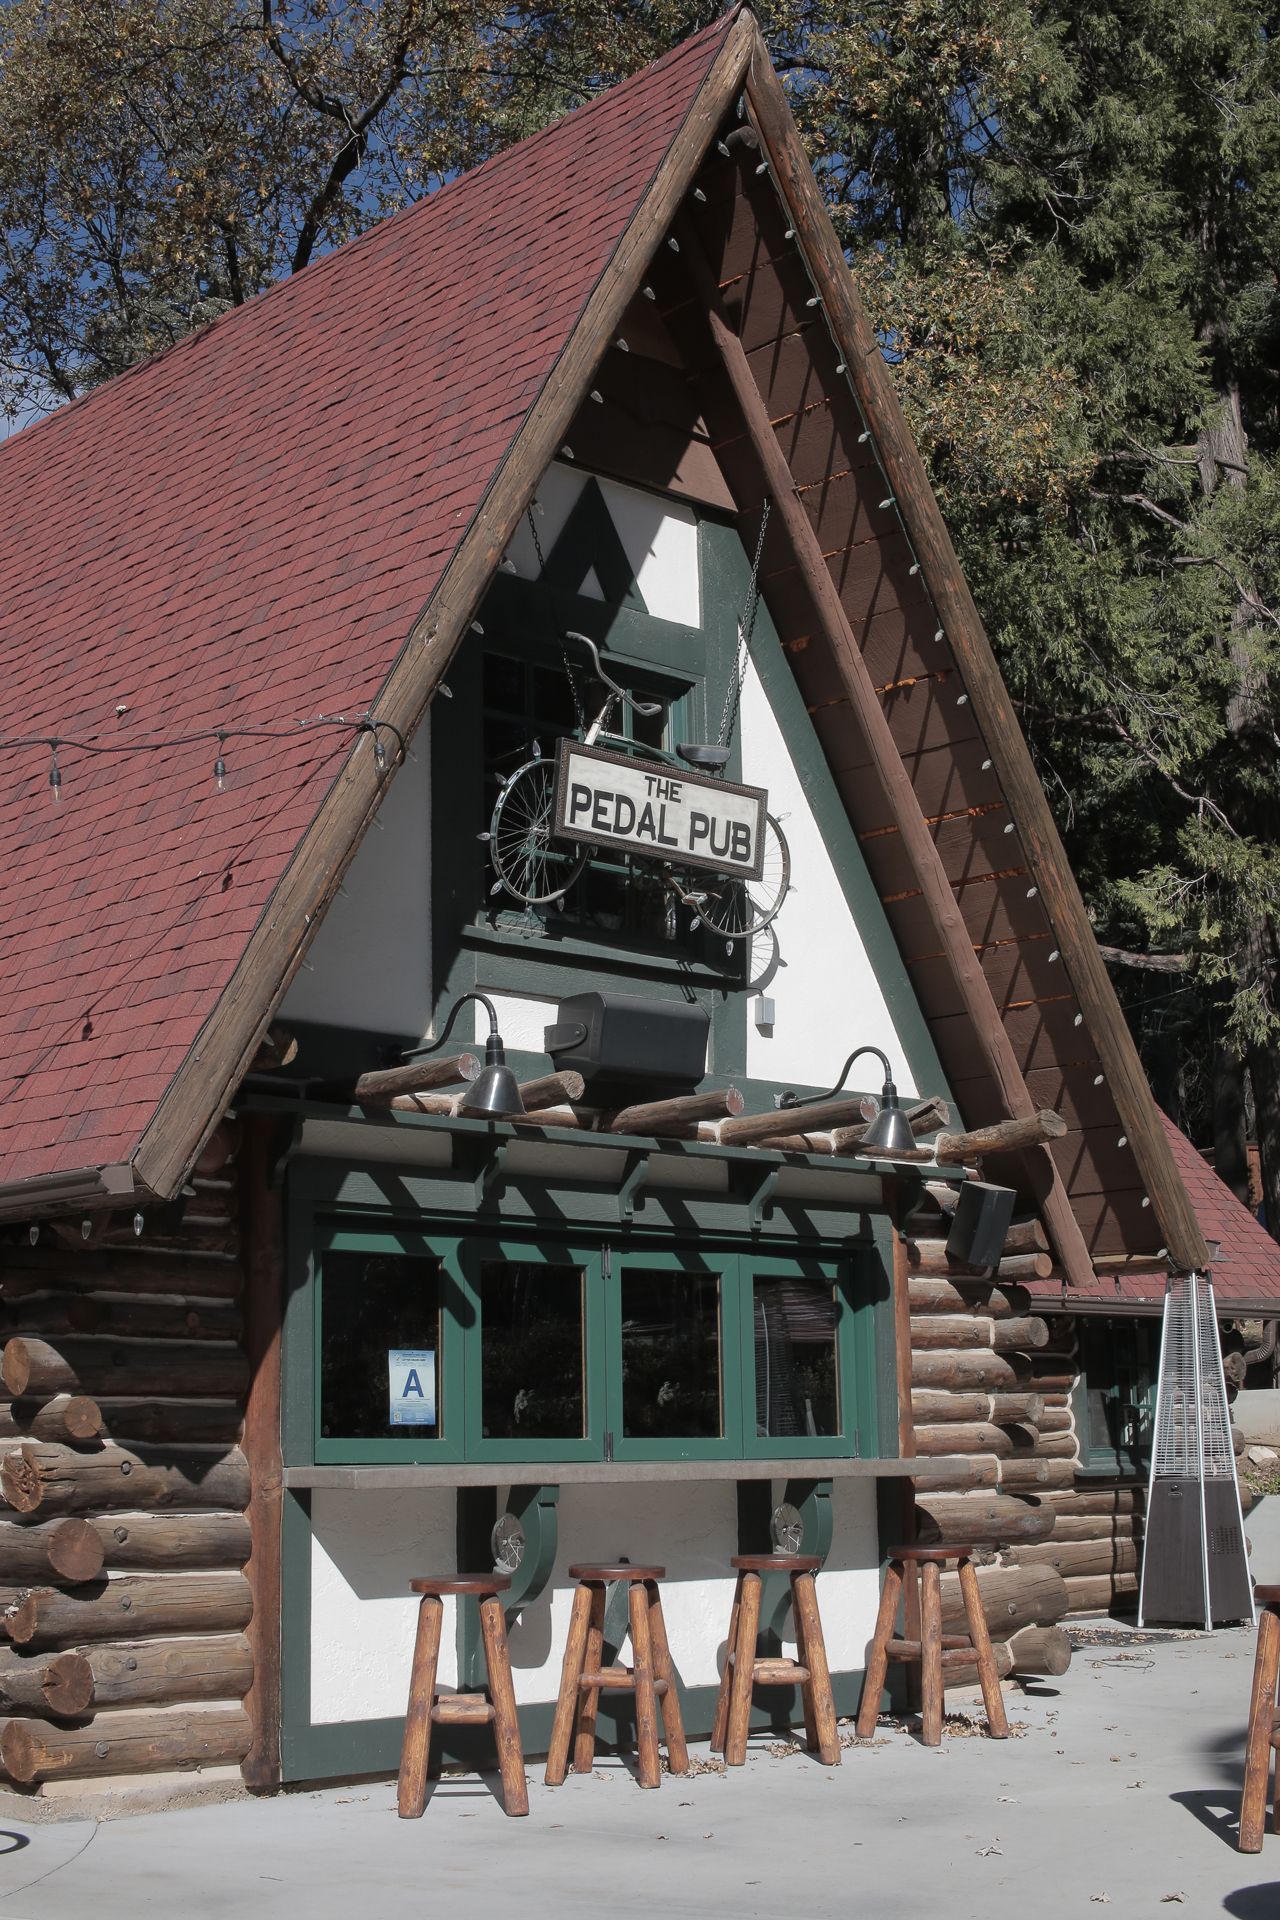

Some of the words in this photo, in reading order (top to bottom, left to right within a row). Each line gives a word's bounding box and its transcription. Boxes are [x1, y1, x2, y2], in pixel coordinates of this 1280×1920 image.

[644, 775, 683, 804] THE
[569, 783, 678, 846] PEDAL
[689, 811, 751, 862] PUB
[402, 1368, 425, 1398] A
